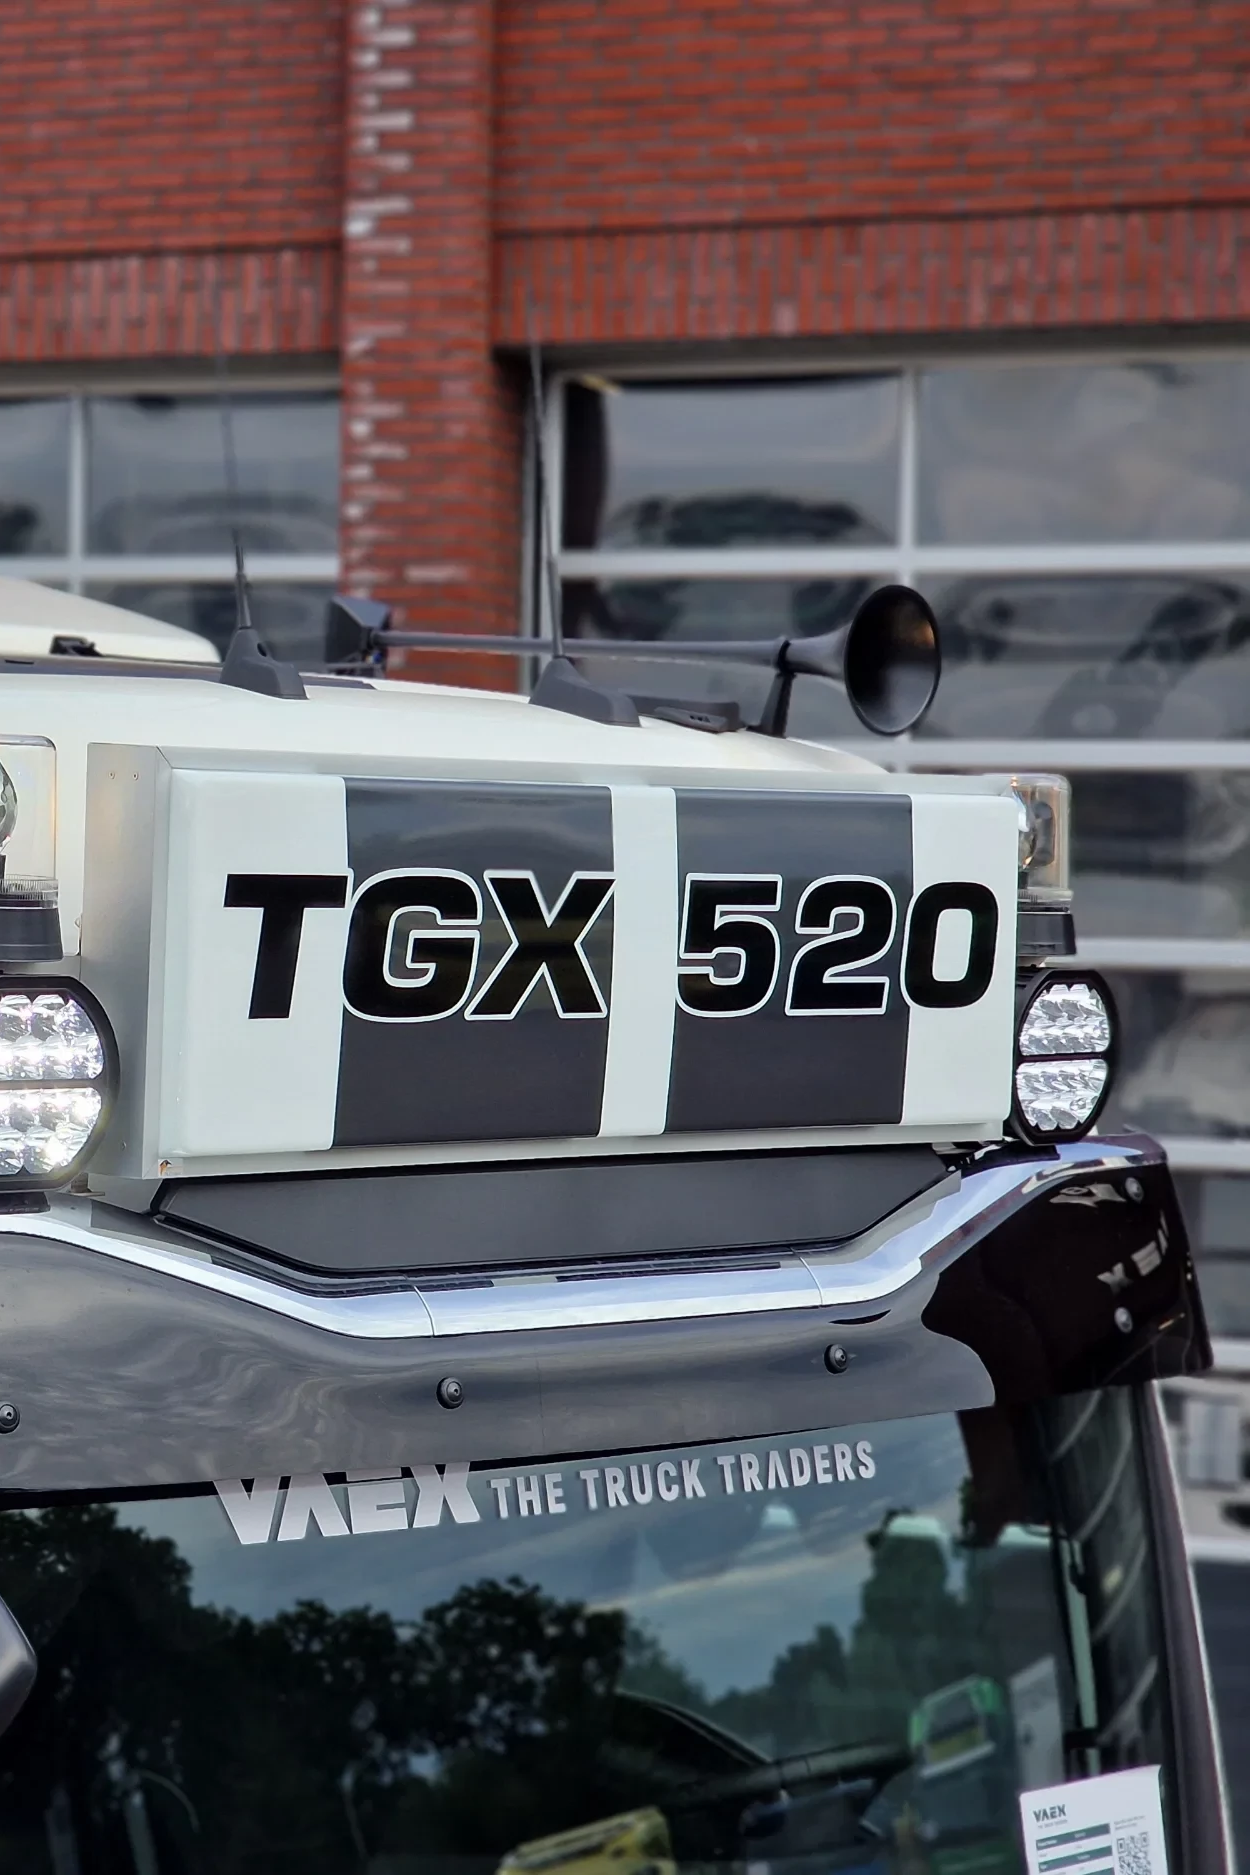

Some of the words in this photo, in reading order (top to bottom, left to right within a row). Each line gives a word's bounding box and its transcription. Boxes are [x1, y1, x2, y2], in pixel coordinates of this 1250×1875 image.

[223, 868, 617, 1023] TGX
[676, 873, 1000, 1018] 520
[213, 1462, 480, 1544] VAEX
[489, 1474, 567, 1520] THE
[579, 1459, 706, 1510] TRUCK
[715, 1441, 876, 1494] TRADERS
[1033, 1804, 1067, 1822] VAEX
